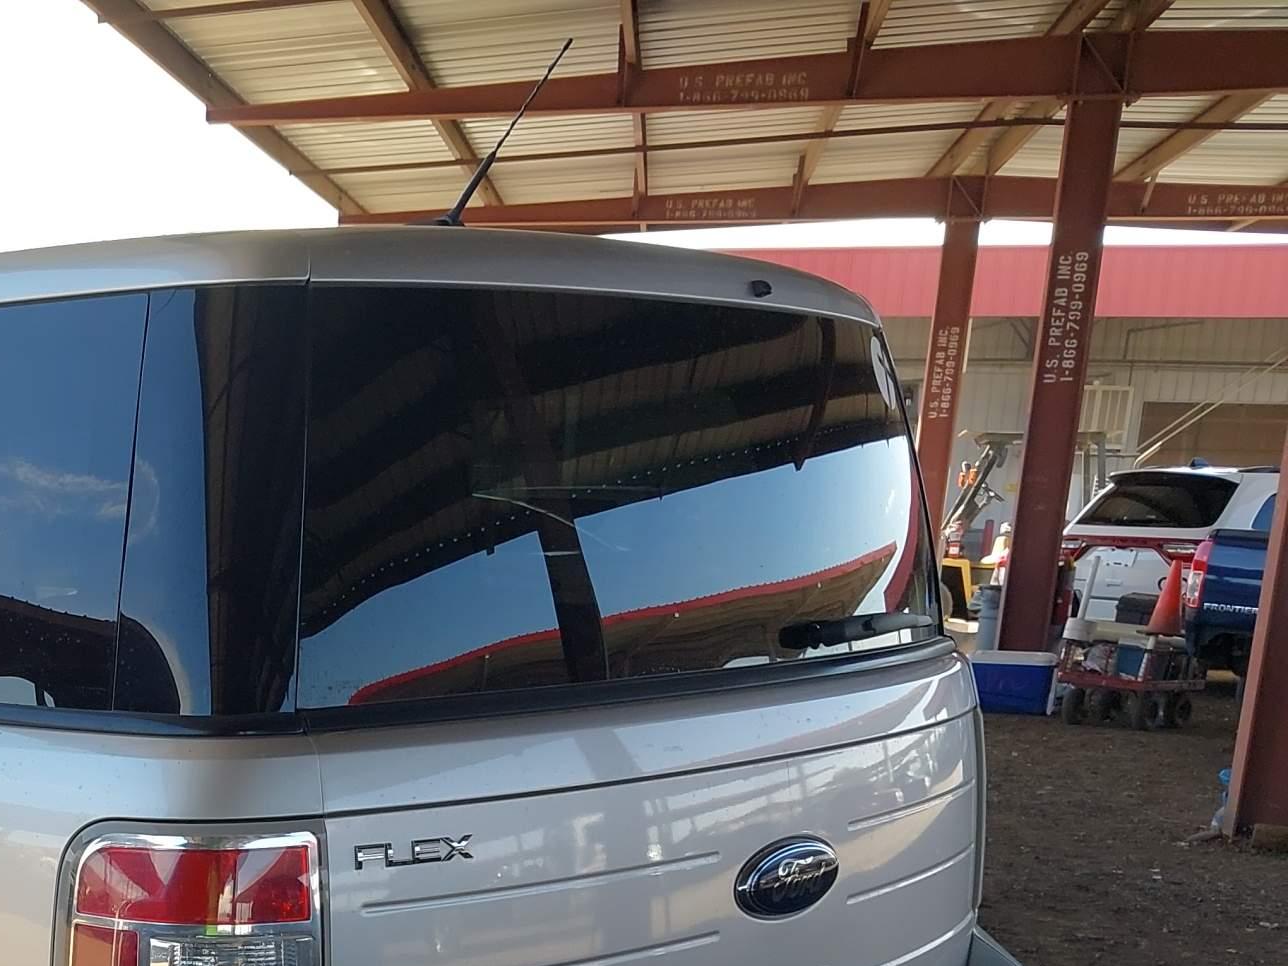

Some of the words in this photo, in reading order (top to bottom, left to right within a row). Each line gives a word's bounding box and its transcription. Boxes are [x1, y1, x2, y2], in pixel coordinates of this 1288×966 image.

[715, 72, 775, 88] PREFAB
[1048, 287, 1068, 346] PREFAB
[1060, 251, 1089, 382] 1-866-799-0969
[931, 351, 946, 393] PREFAB
[1203, 602, 1259, 615] FRONTIER
[354, 833, 474, 871] FLEX
